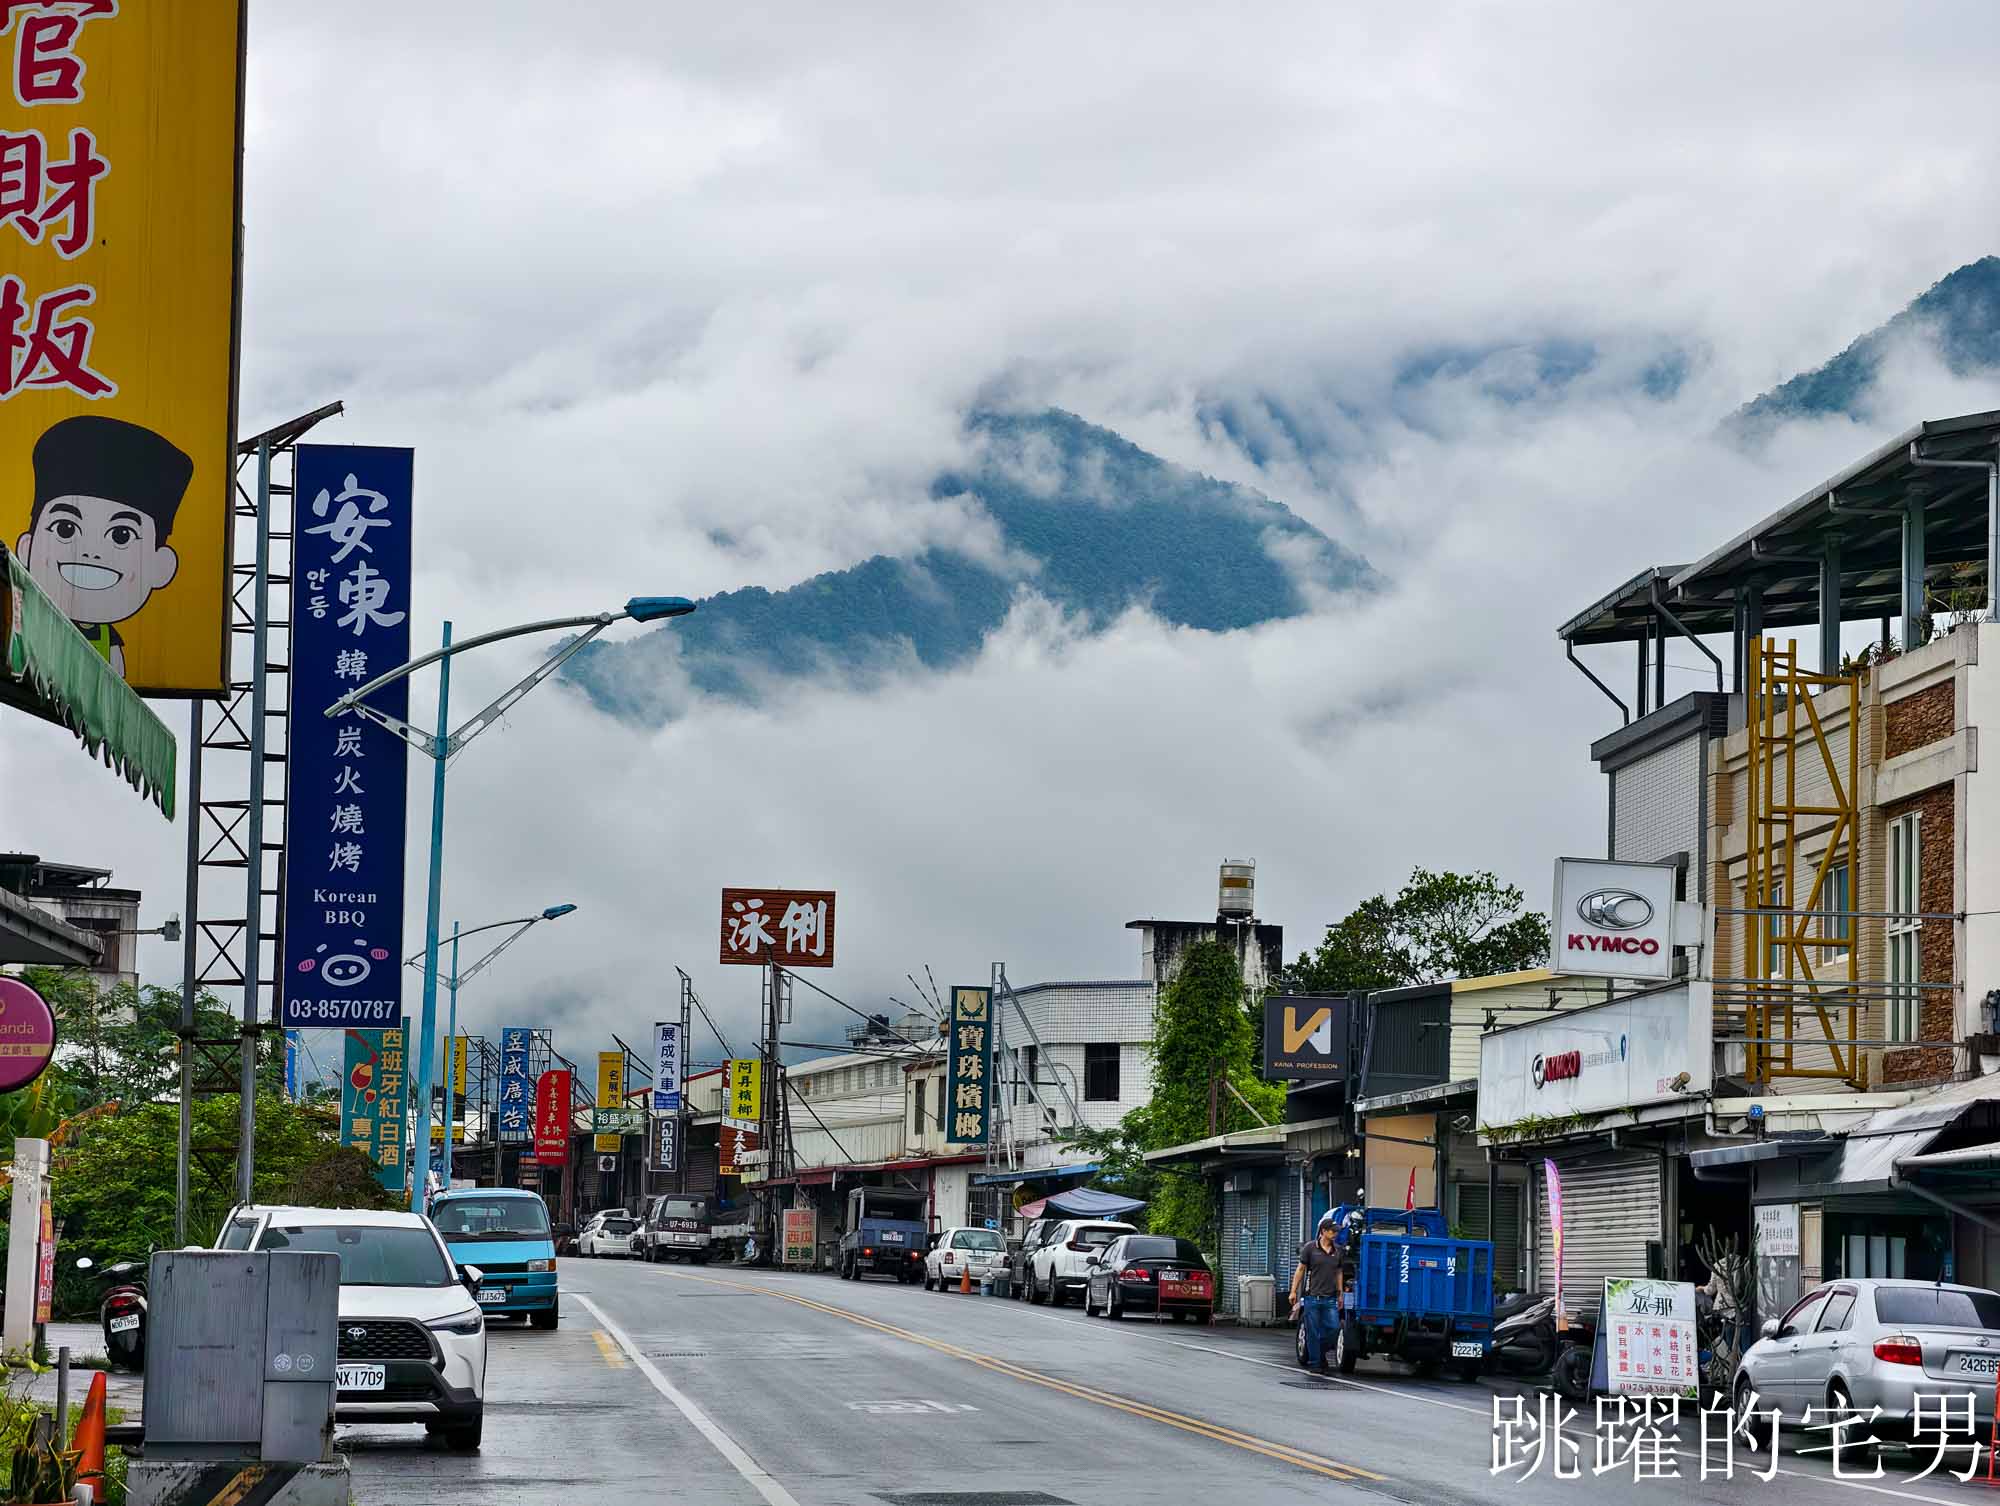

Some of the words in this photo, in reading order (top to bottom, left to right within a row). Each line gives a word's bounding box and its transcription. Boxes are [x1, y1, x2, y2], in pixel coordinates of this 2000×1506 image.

[304, 472, 406, 636] 安東
[306, 568, 331, 619] 안동
[313, 888, 377, 904] Korean
[324, 910, 366, 927] BBQ
[728, 899, 827, 957] 泳俐
[1567, 933, 1660, 956] KYMCO
[290, 999, 395, 1019] 03-8570787
[660, 1026, 676, 1092] 展成汽車
[1296, 1062, 1338, 1070] PROFESSION
[1544, 1050, 1582, 1082] KYMCO
[377, 1030, 404, 1167] 西班牙紅白酒
[501, 1031, 528, 1129] 昱威廣告
[607, 1069, 619, 1106] 名展汽
[955, 1025, 985, 1139] 寶珠檳榔
[1400, 1245, 1409, 1283] 7222
[1447, 1258, 1456, 1277] M2
